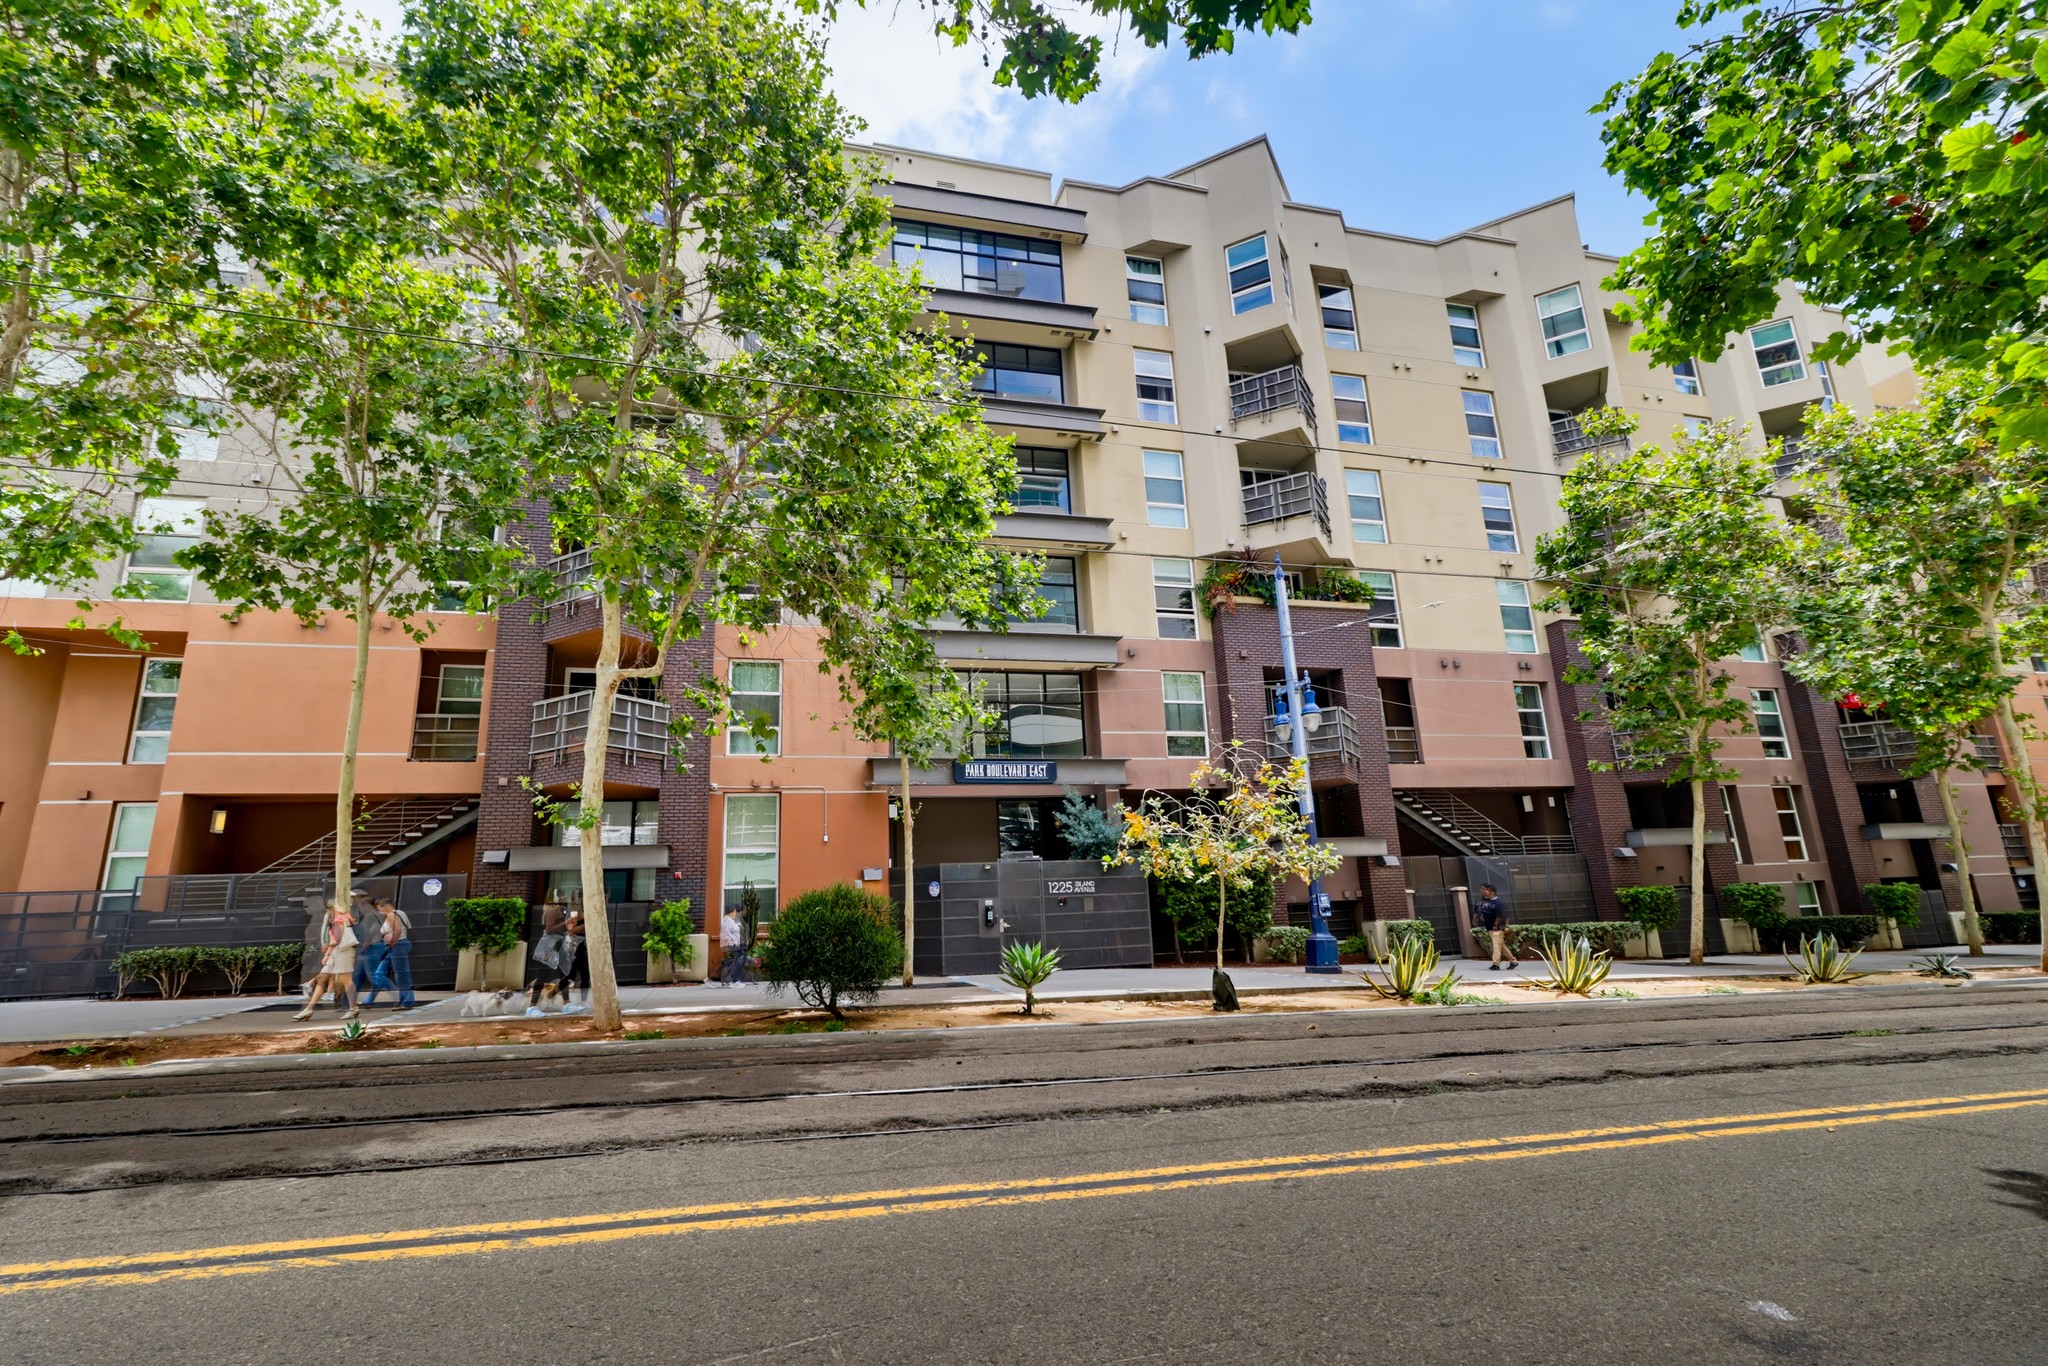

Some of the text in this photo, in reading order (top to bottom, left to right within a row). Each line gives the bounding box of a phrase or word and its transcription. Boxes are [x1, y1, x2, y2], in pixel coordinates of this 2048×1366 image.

[965, 763, 1048, 777] PARK BOULEVARD EAST
[1048, 881, 1073, 894] 1225
